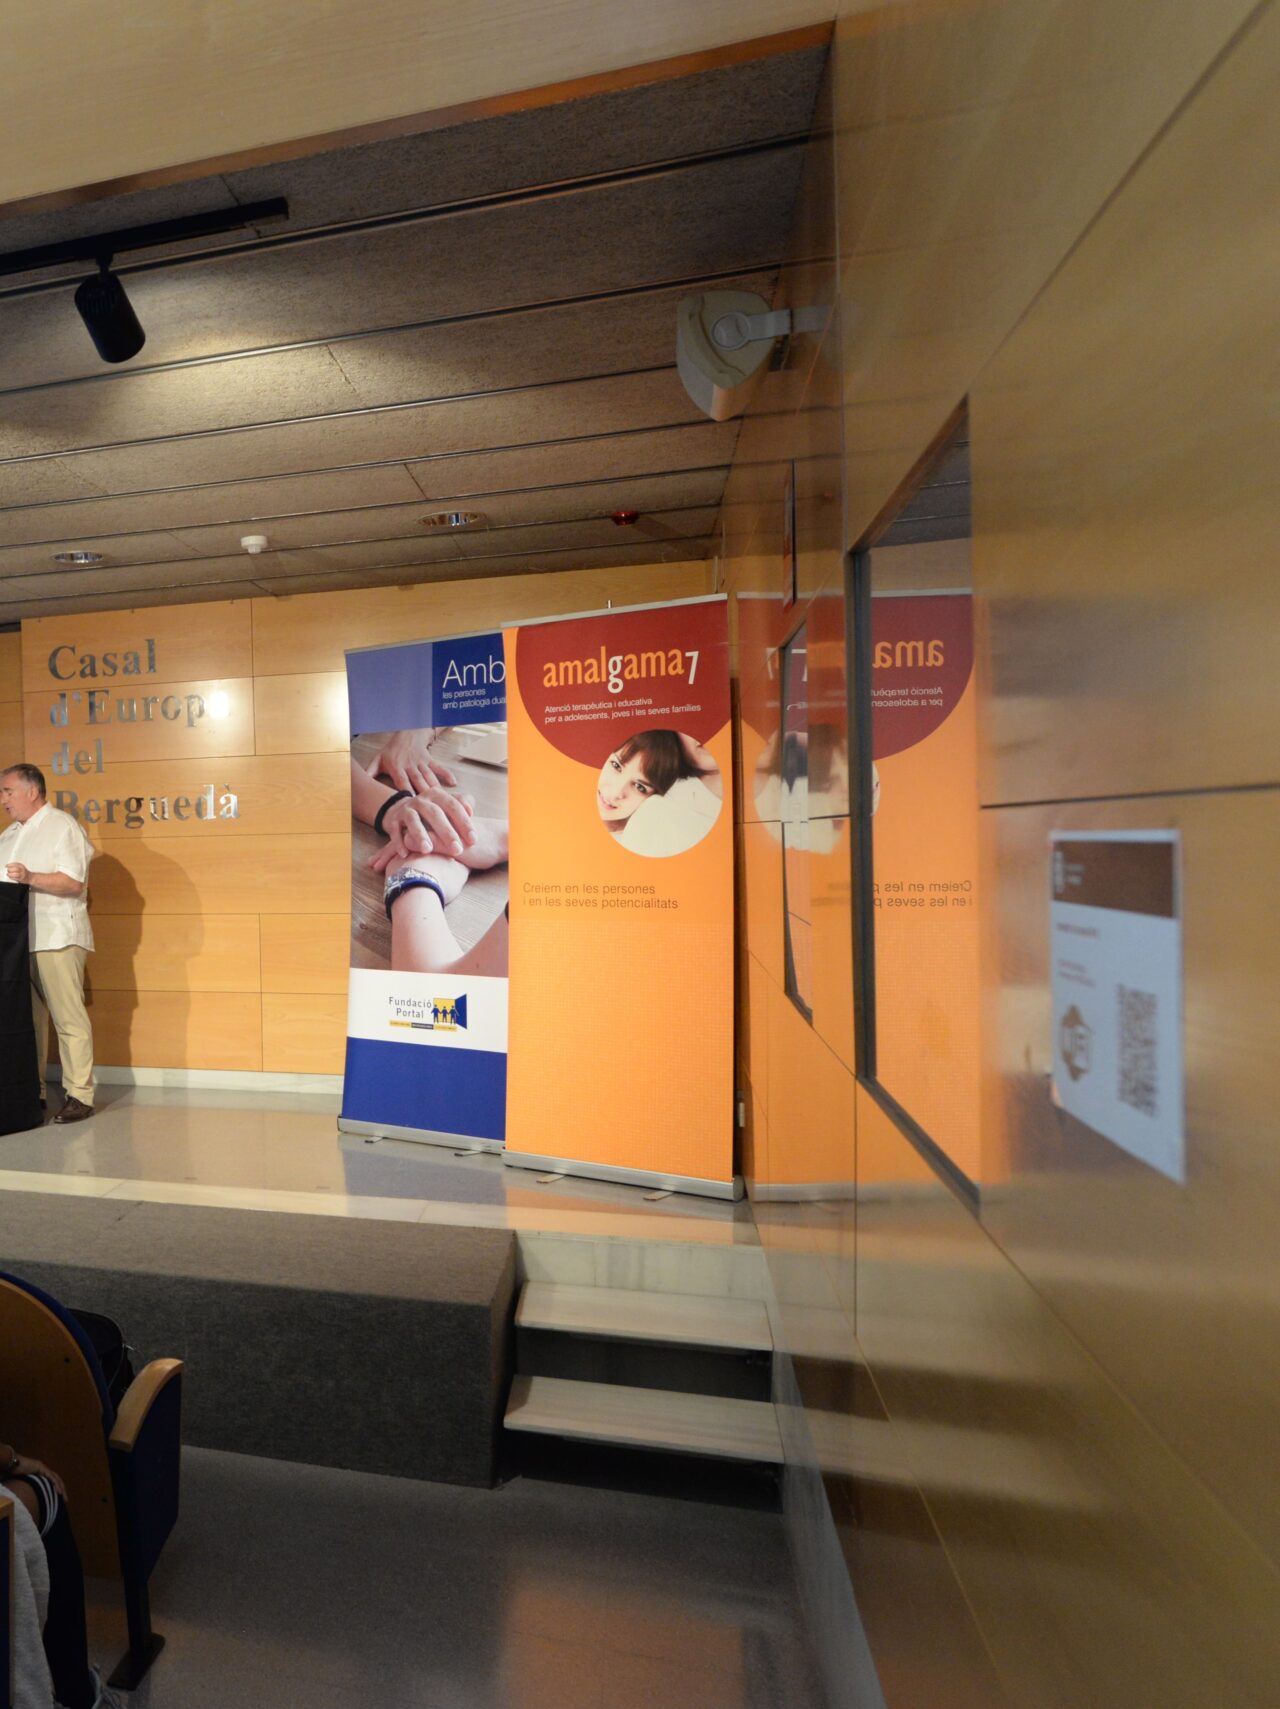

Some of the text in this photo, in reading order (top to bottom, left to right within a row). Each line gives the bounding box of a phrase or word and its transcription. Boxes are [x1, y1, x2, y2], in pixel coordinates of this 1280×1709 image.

[48, 639, 157, 681] Casal
[442, 655, 506, 688] Amb
[543, 646, 699, 694] amalgama7
[443, 688, 486, 699] les persones
[50, 689, 230, 728] d'Europ
[443, 696, 506, 710] amb patologia dua
[545, 703, 571, 713] Atenció
[618, 697, 653, 707] educativa
[545, 715, 556, 724] per
[611, 710, 630, 720] joves
[635, 708, 646, 716] les
[648, 707, 670, 716] seves
[51, 739, 104, 776] del
[54, 784, 240, 829] Berguedà
[523, 882, 655, 896] Creiem en les persones
[529, 897, 542, 906] en
[545, 896, 562, 907] les
[565, 898, 597, 907] seves
[601, 897, 679, 910] potencialitats
[388, 996, 432, 1008] Fundació
[396, 1008, 424, 1018] Portal
